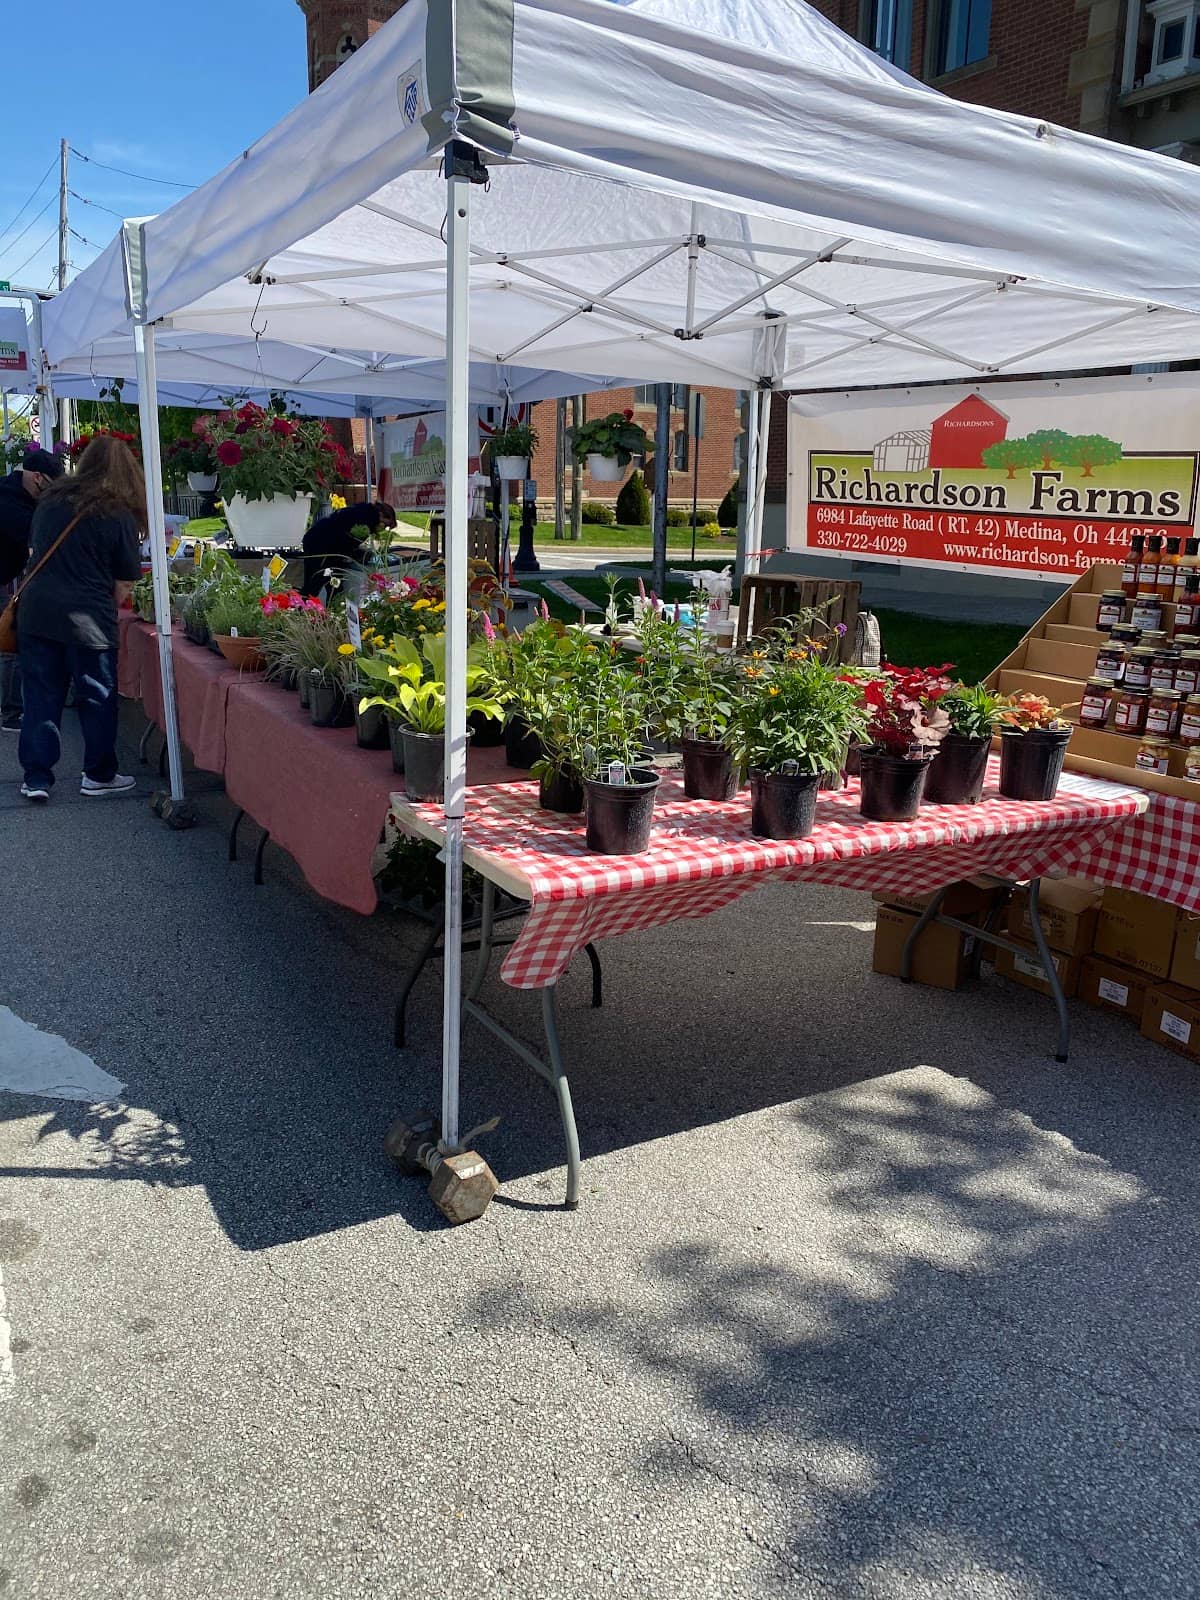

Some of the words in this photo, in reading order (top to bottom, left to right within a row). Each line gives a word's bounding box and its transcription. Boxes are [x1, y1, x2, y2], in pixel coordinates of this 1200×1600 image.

[815, 467, 1007, 508] Richardson
[1029, 472, 1180, 517] Farms
[816, 507, 846, 524] 6984
[848, 509, 899, 530] Lafayette
[902, 513, 934, 532] Road
[974, 518, 1000, 540] 42)
[1004, 519, 1067, 545] Medina,
[1073, 523, 1098, 544] Oh
[816, 530, 907, 553] 330-722-4029
